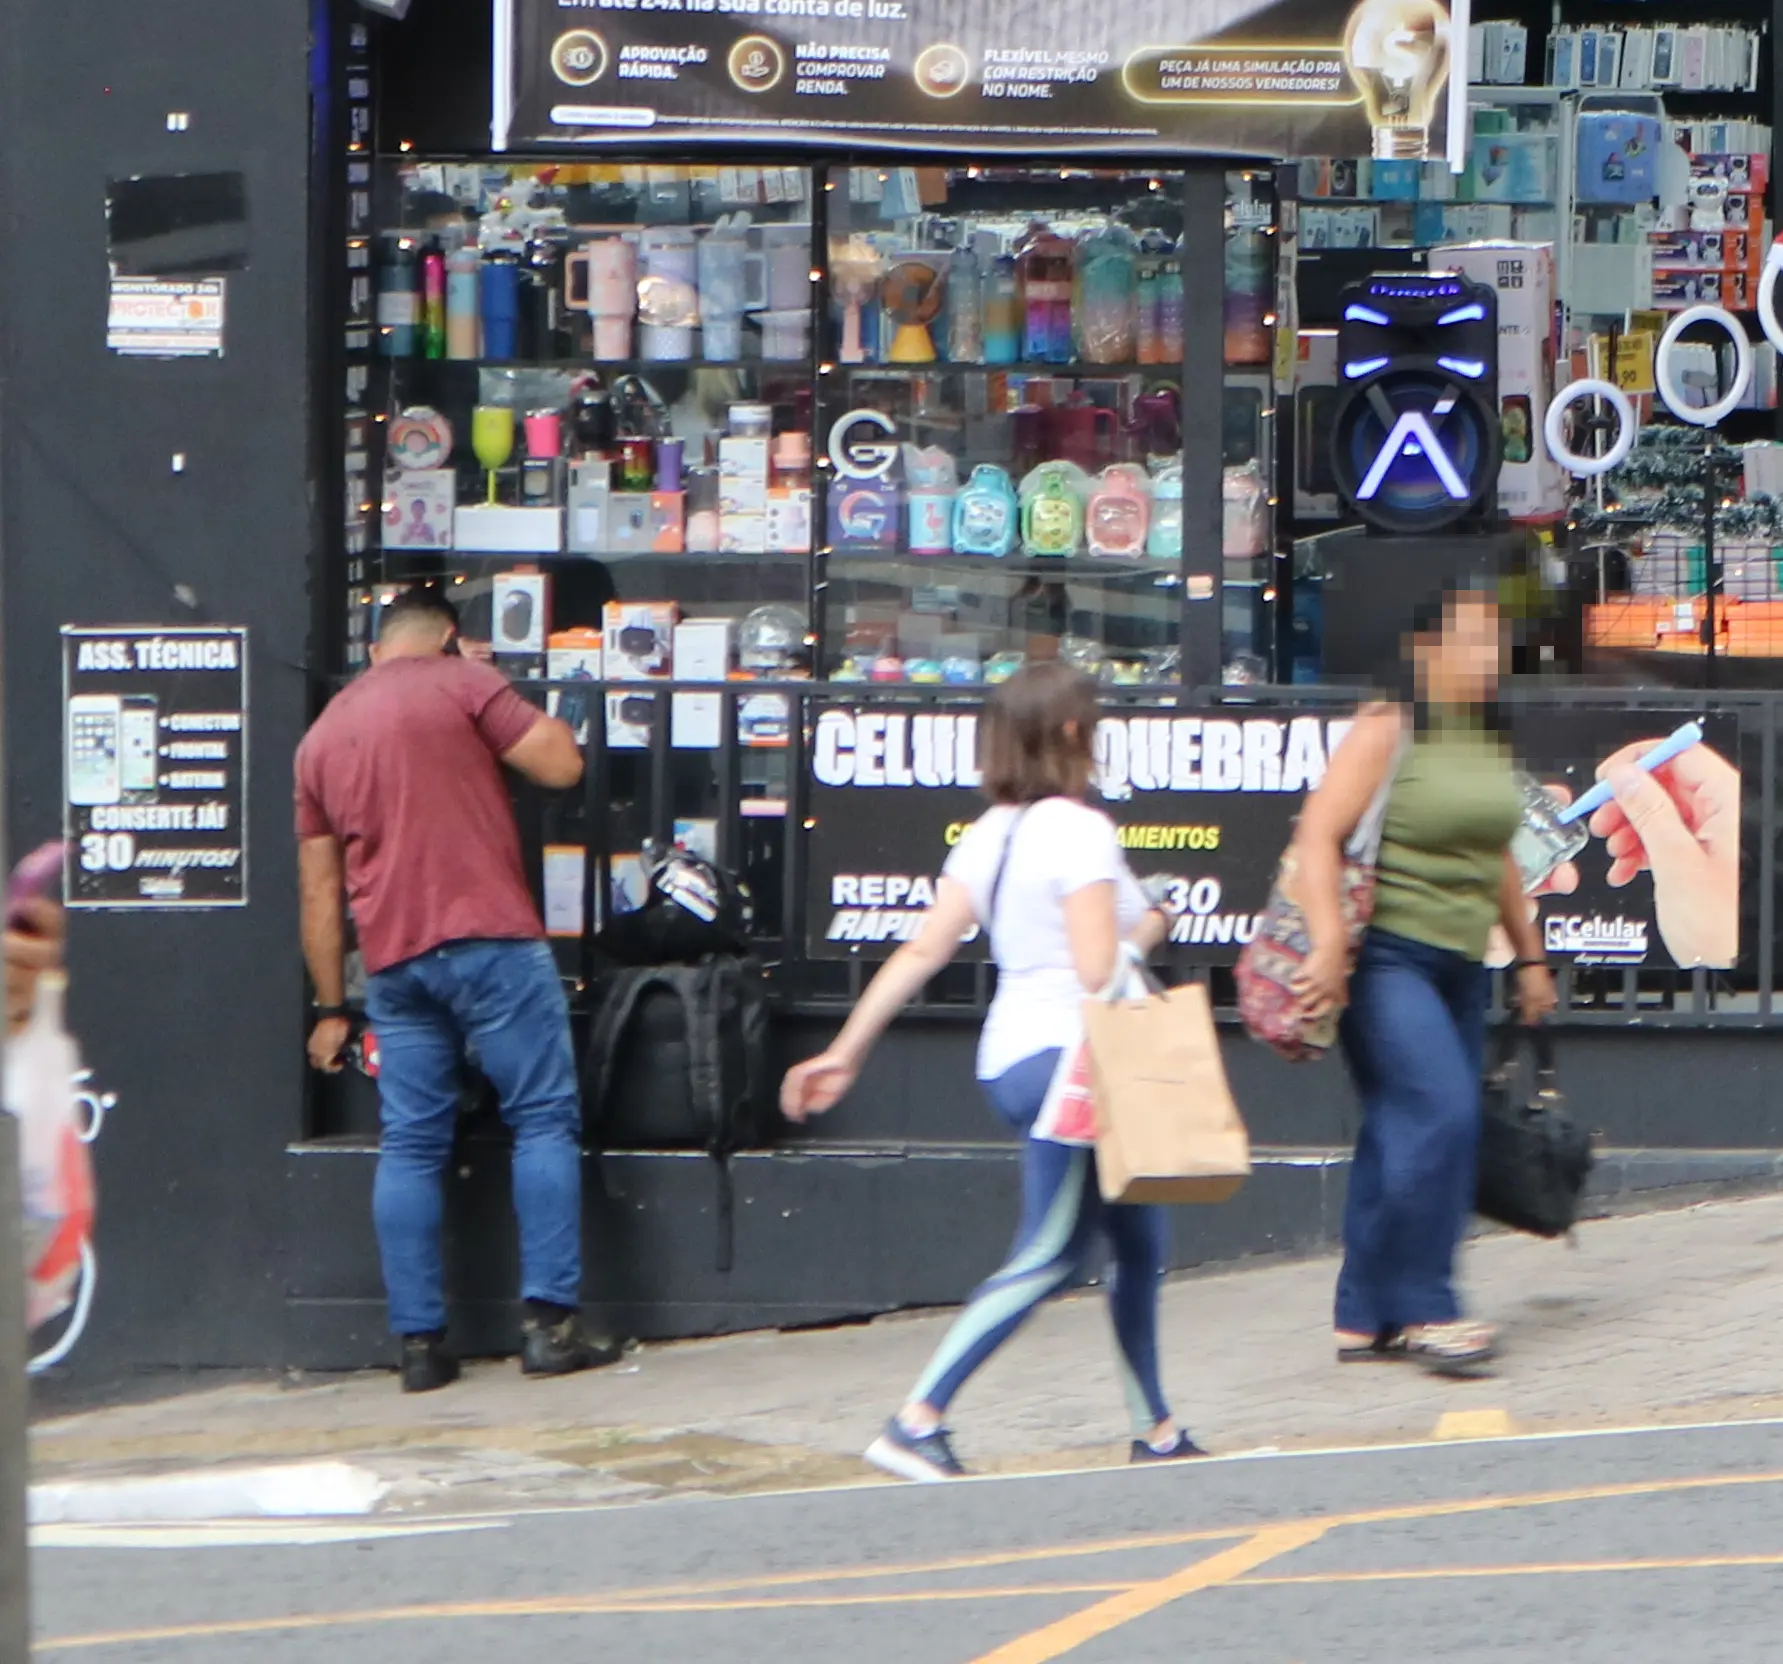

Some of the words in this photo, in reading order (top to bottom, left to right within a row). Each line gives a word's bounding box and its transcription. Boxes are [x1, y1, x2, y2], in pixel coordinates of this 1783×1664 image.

[619, 44, 708, 66] APROVAÇÃO
[795, 42, 829, 59] NÃO
[830, 45, 890, 61] PRECISA
[984, 47, 1052, 64] FLEXÍVEL
[1054, 50, 1109, 65] MESMO
[618, 62, 678, 80] RÁPIDA.
[796, 62, 885, 79] COMPROVAR
[983, 65, 1018, 80] COM
[1019, 64, 1097, 84] RESTRIÇÃO
[1159, 60, 1192, 76] PEÇA
[1193, 58, 1211, 74] JÁ
[1212, 61, 1241, 74] UMA
[1243, 59, 1316, 76] SIMULAÇÃO
[1316, 61, 1341, 74] PRA
[796, 79, 849, 96] RENDA.
[982, 82, 1005, 98] NO
[1007, 83, 1053, 99] NOME.
[1161, 77, 1183, 89] UM
[1184, 77, 1200, 89] DE
[1201, 77, 1254, 90] NOSSOS
[1256, 77, 1340, 91] VENDEDORES!
[77, 641, 133, 671] ASS.
[134, 636, 237, 671] TÉCNICA
[813, 710, 984, 788] CELUL
[1090, 716, 1356, 801] QUEBRA
[91, 804, 194, 830] CONSERTE
[196, 799, 228, 830] JÁ!
[1115, 825, 1221, 850] AMENTOS
[80, 833, 133, 871] 30
[134, 848, 240, 869] MINUTOS!
[832, 874, 942, 906] REPA
[1165, 877, 1221, 914] 30
[1169, 914, 1266, 943] MINU
[1566, 915, 1648, 938] Celular
